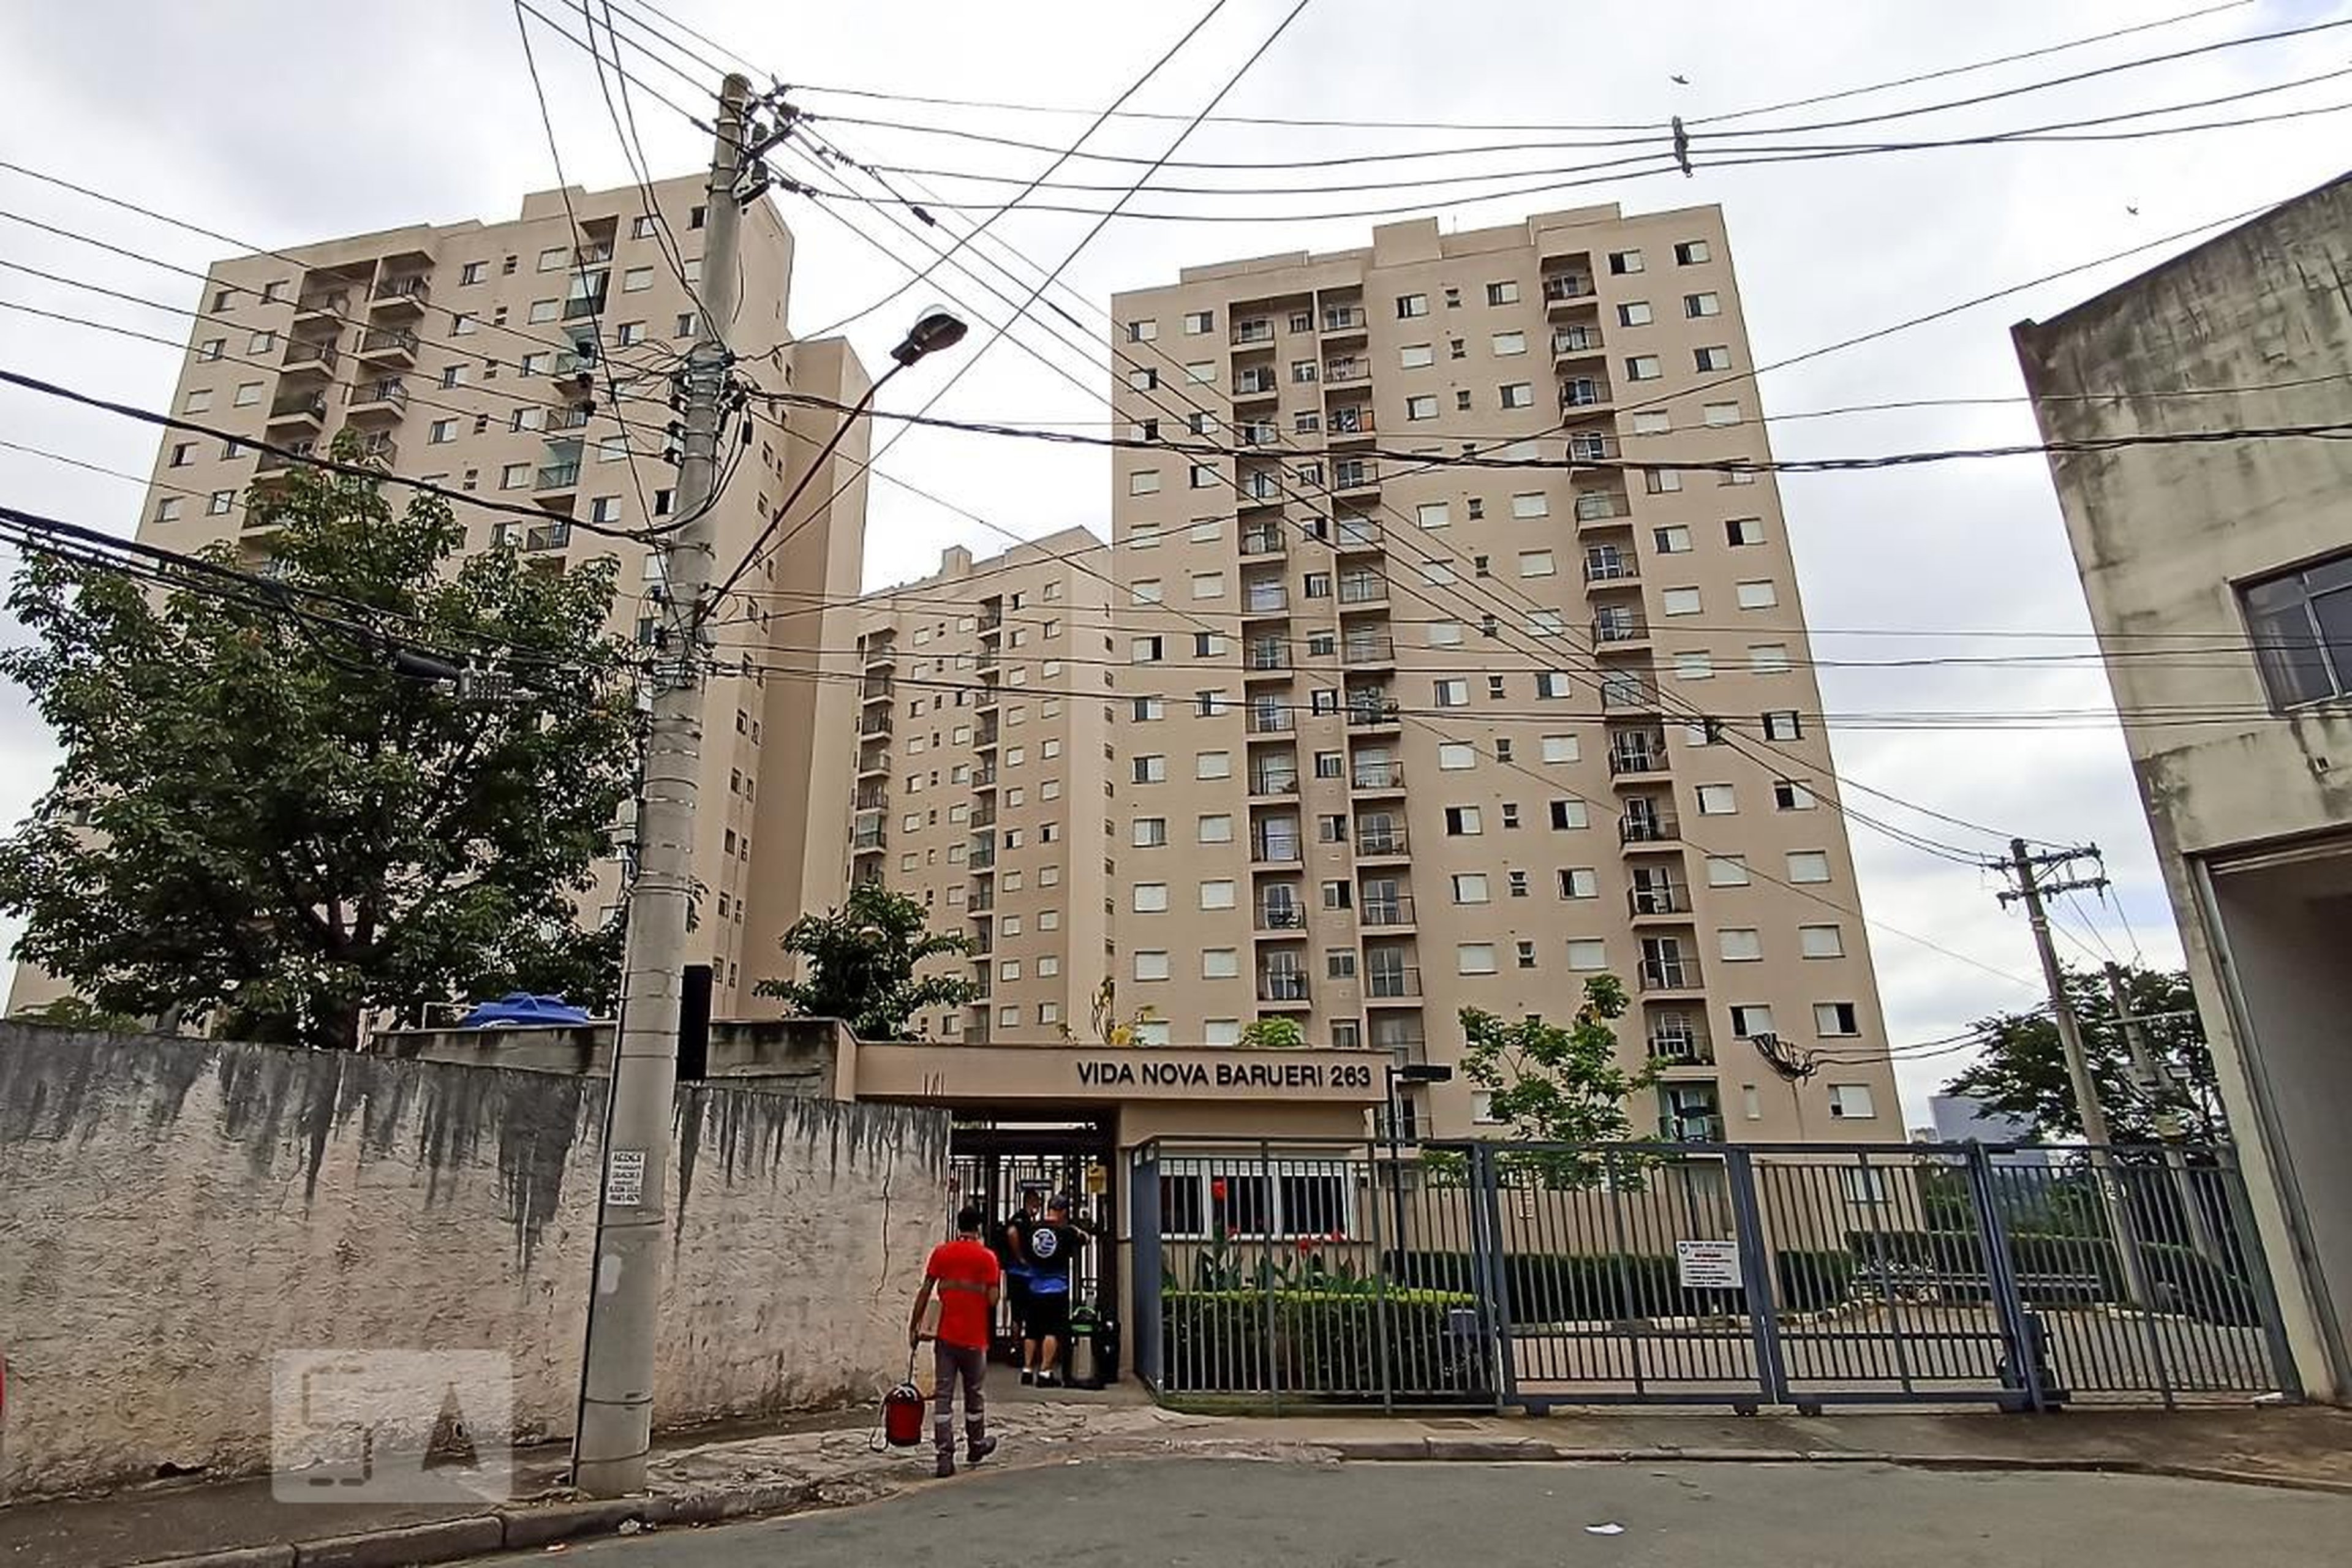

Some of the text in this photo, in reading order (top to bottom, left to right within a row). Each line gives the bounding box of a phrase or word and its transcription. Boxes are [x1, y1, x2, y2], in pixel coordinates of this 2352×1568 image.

[1077, 1061, 1371, 1088] VIDA NOVA BARUERI 263
